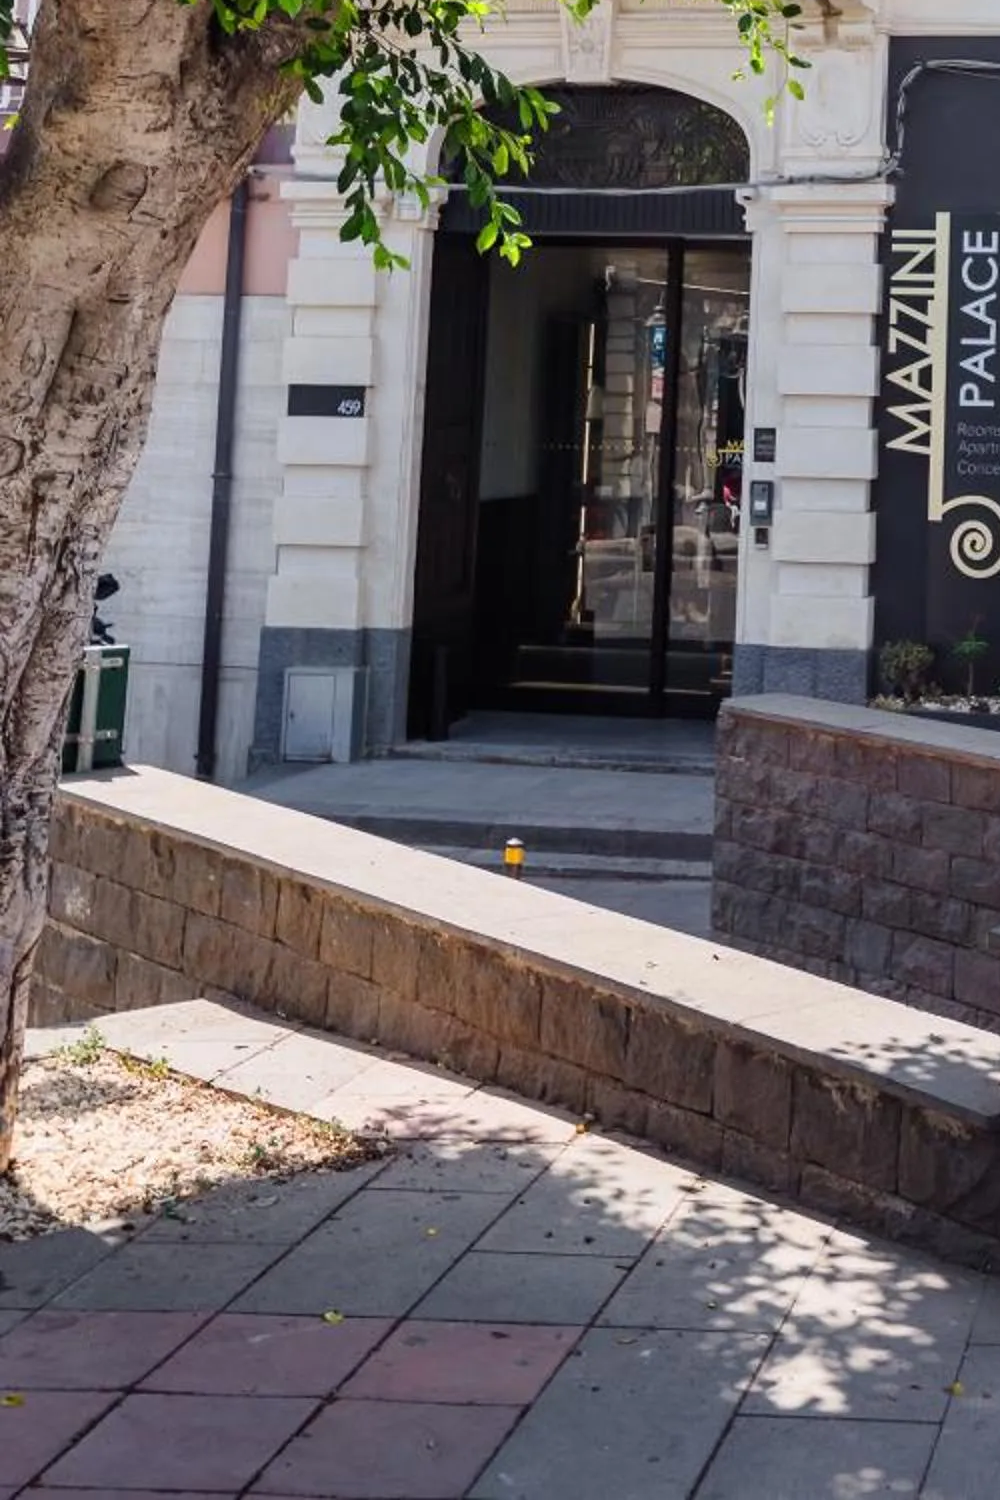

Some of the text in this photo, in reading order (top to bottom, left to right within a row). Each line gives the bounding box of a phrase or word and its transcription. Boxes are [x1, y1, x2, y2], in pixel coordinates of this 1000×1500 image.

[337, 399, 361, 415] 459
[886, 228, 938, 456] MAZZINI
[958, 229, 1000, 408] PALACE
